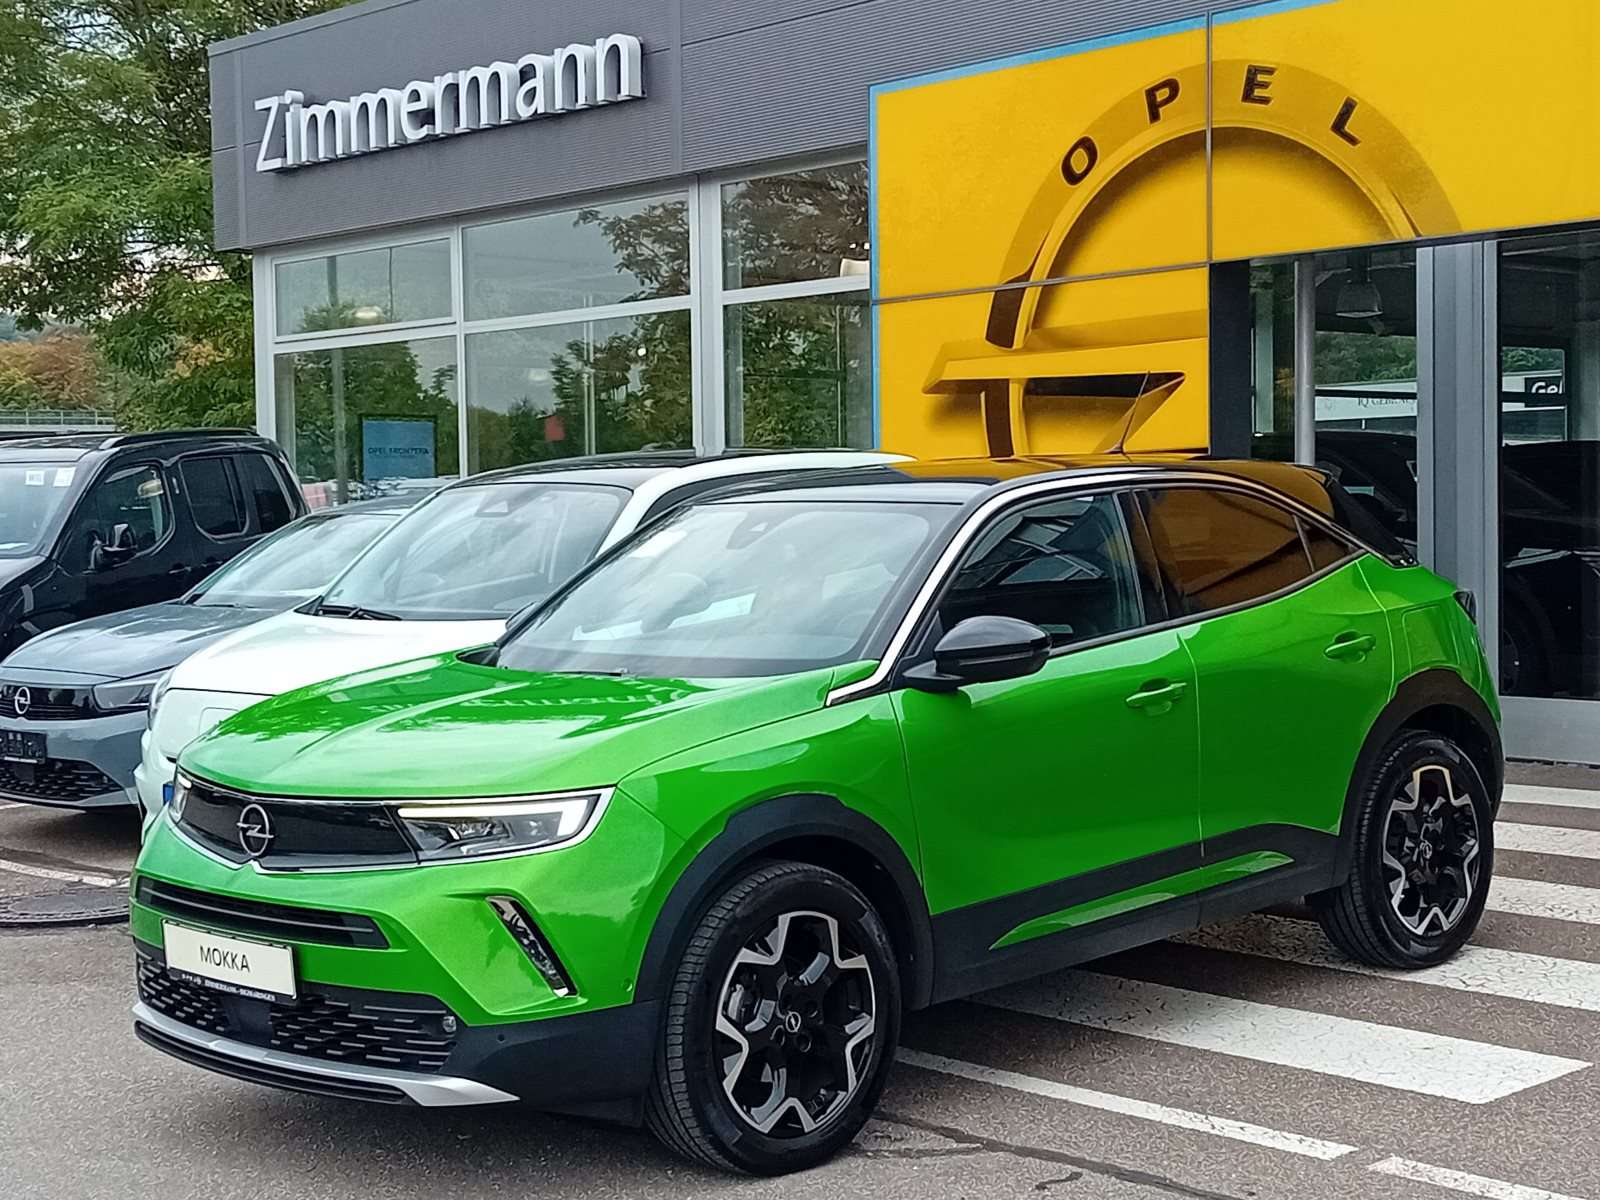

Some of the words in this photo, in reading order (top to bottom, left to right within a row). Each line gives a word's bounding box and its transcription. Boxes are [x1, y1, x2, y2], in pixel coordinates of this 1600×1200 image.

[254, 33, 643, 172] Zimmermann
[1060, 63, 1362, 186] OPEL
[199, 945, 251, 973] MOKKA
